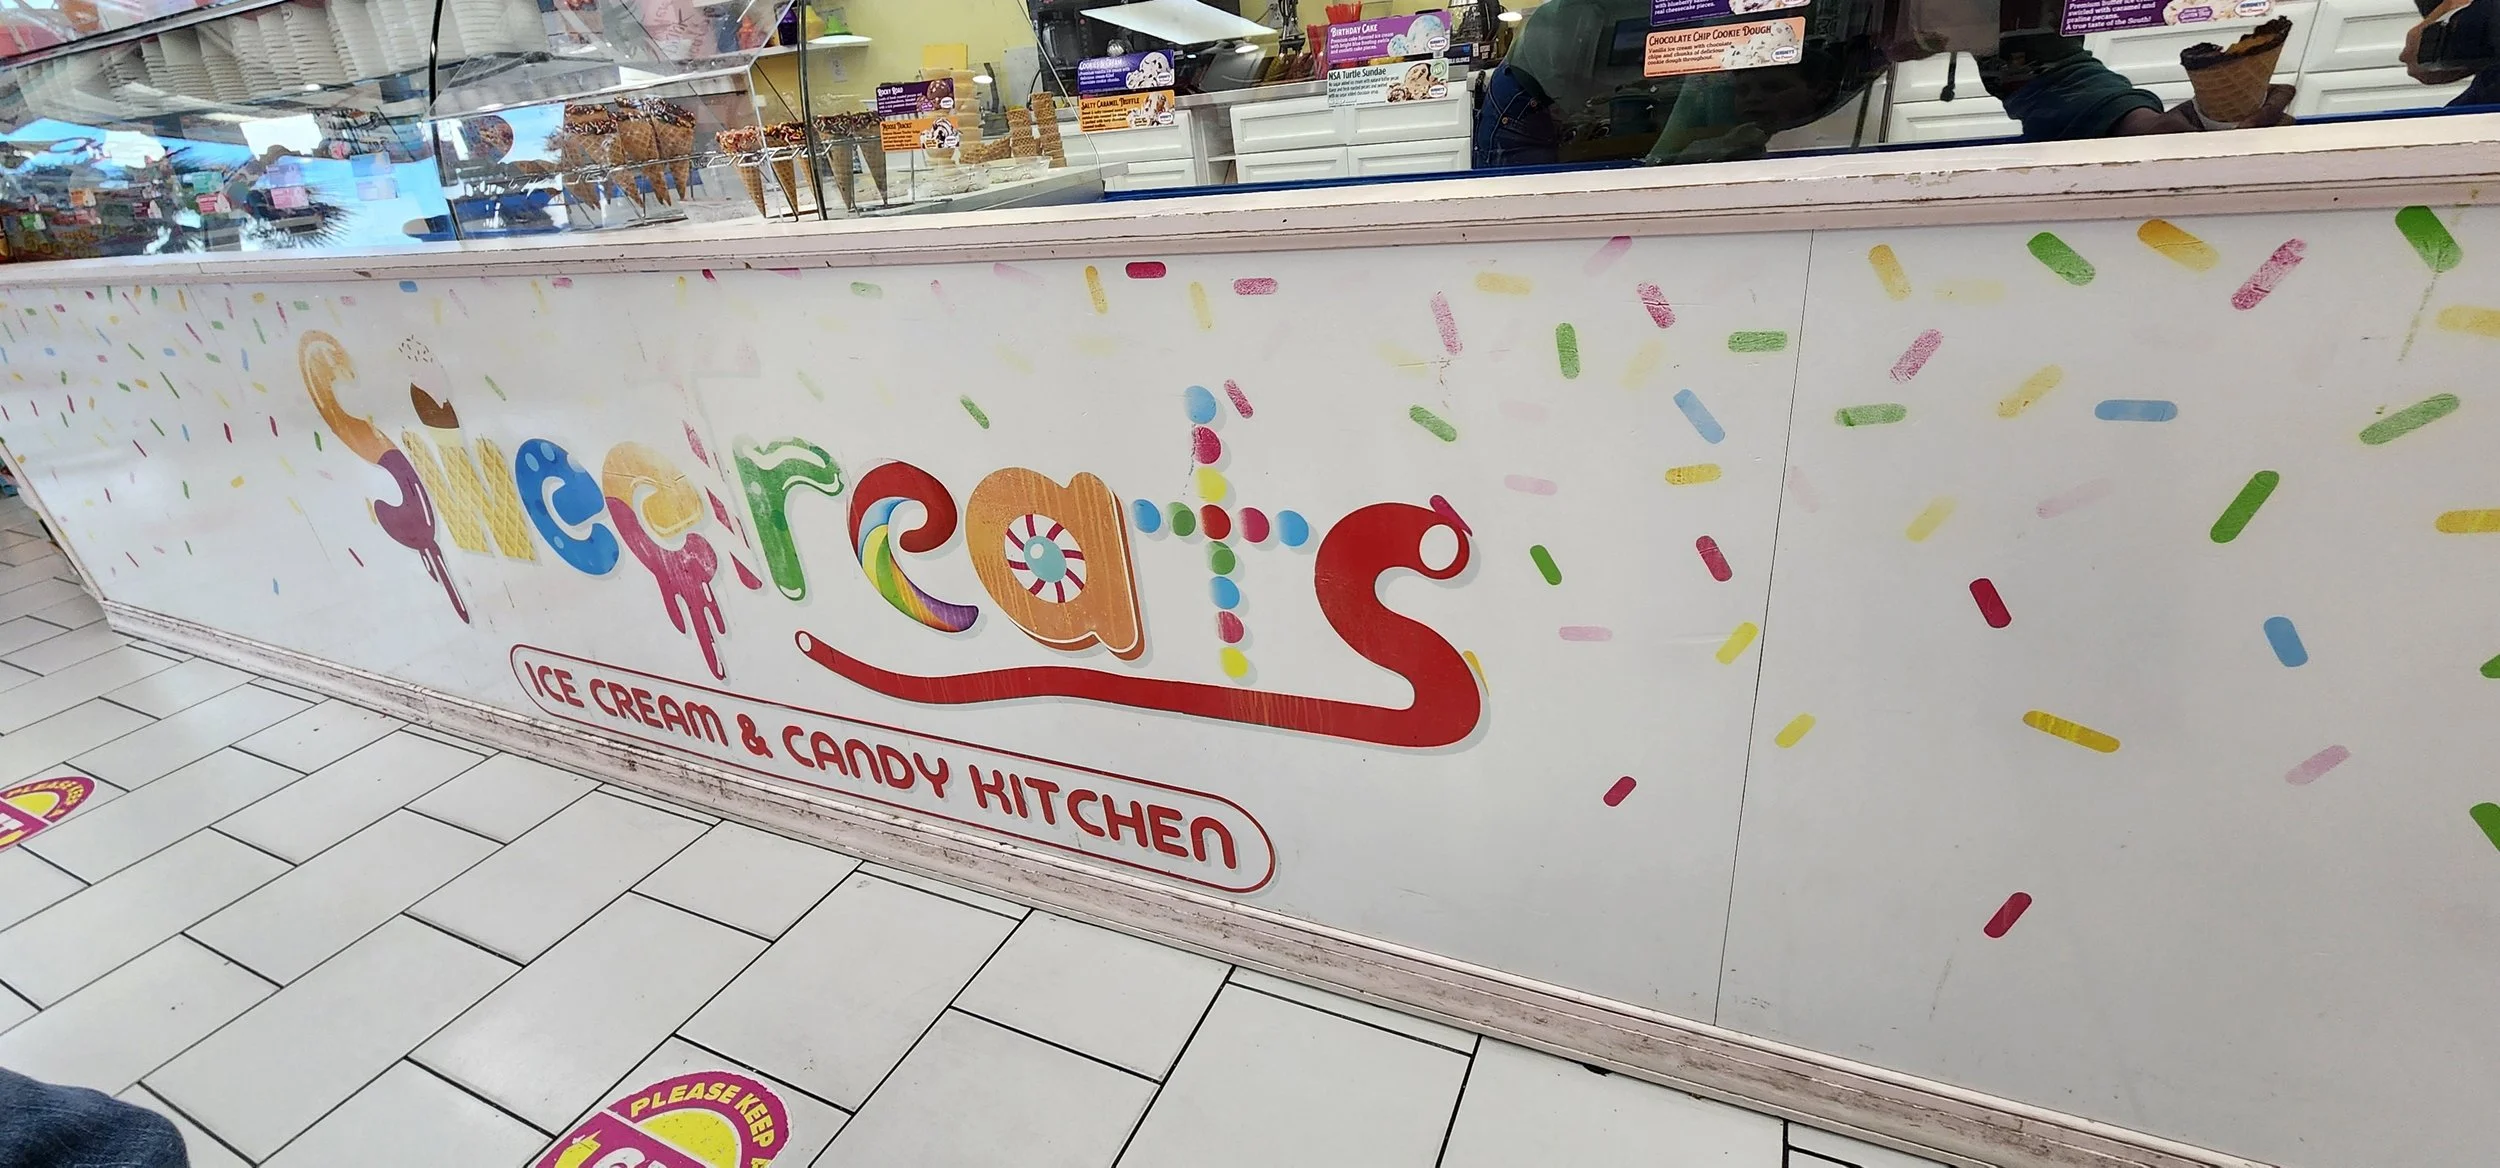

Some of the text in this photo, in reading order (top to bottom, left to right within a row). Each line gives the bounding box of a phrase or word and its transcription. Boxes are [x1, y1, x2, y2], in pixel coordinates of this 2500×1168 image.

[1330, 24, 1378, 37] BIRTHDAY CAKE
[1649, 26, 1771, 46] CHOCOLATE CHIP COOKIE DOUGH
[1328, 67, 1387, 81] NSA Turtle Sundae
[1096, 100, 1118, 108] CARAMEL
[525, 660, 1239, 871] ICE CREAM & CANDY KITCHEN
[630, 1081, 777, 1149] PLEASE KEEP
